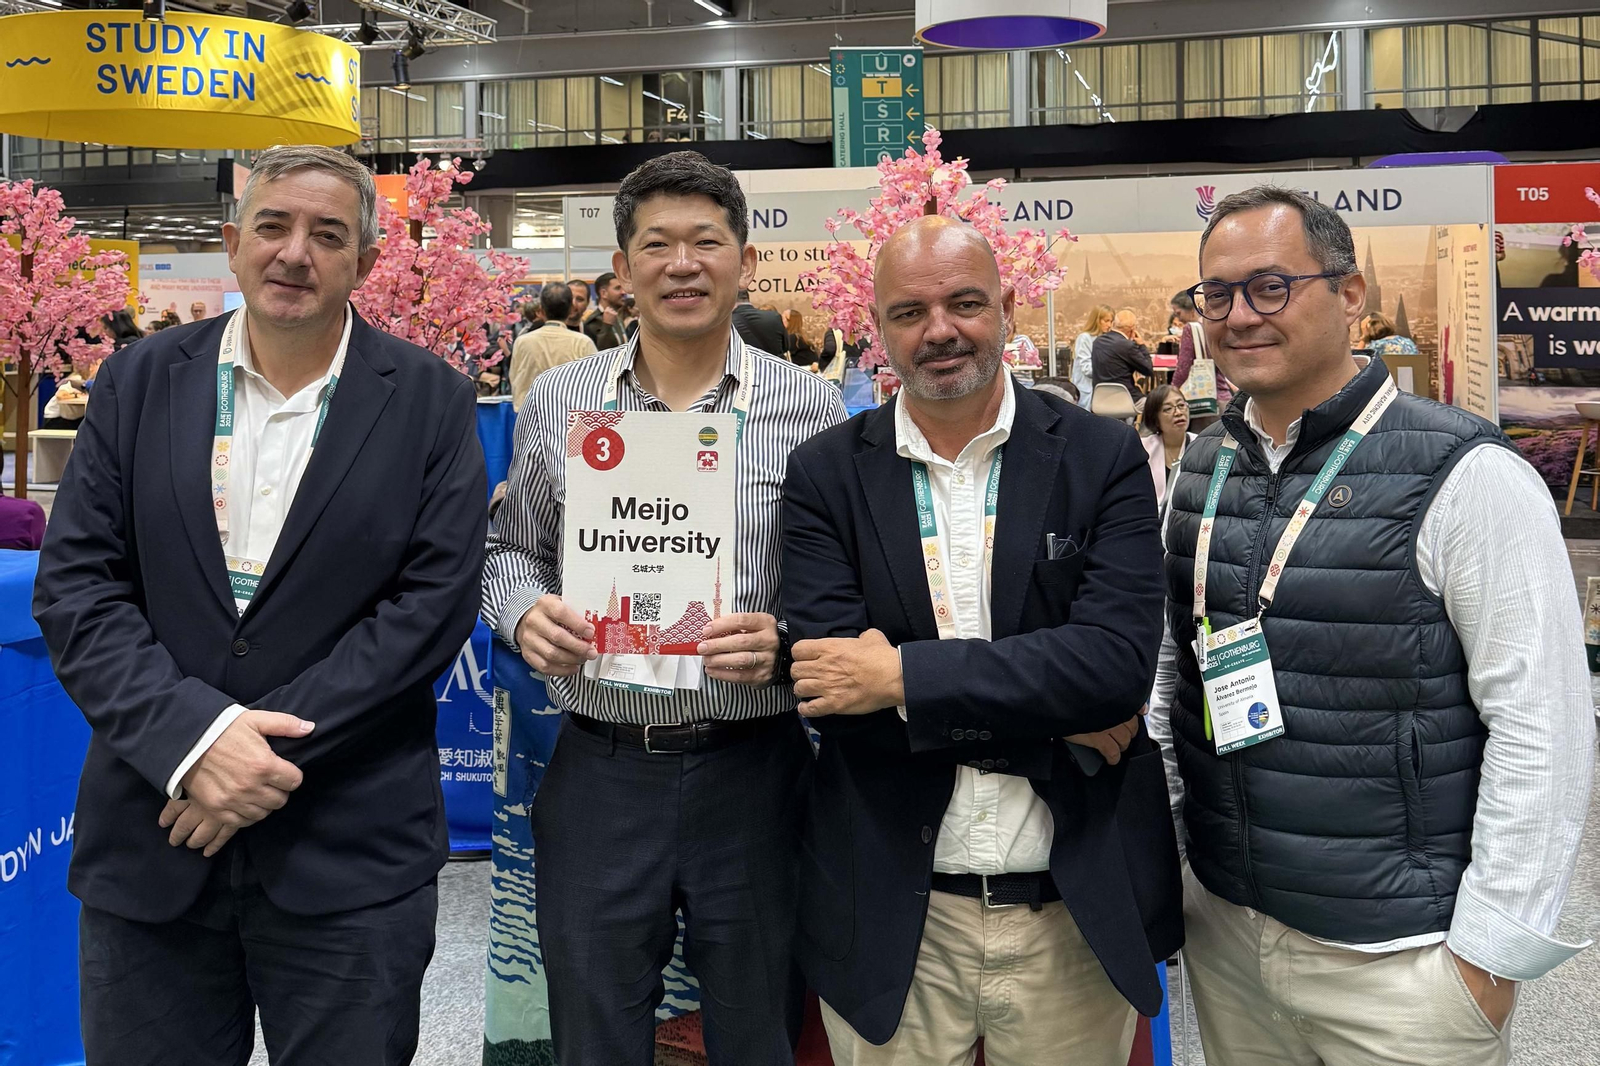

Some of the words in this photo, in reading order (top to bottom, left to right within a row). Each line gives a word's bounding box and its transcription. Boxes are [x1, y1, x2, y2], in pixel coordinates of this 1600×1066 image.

[86, 22, 210, 55] STUDY
[224, 29, 265, 63] IN
[875, 56, 888, 71] U
[97, 64, 255, 101] SWEDEN
[876, 80, 888, 95] T
[666, 108, 689, 123] F4
[877, 103, 889, 119] S
[877, 127, 890, 142] R
[1516, 187, 1549, 202] T05
[579, 208, 600, 219] T07
[780, 247, 798, 262] to
[1503, 301, 1524, 322] A
[1528, 306, 1600, 322] warm
[1548, 333, 1567, 356] is
[220, 370, 229, 411] GOTHENBURG
[596, 437, 611, 462] 3
[1314, 453, 1345, 496] GOTHENBURG
[914, 469, 927, 512] GOTHENBURG
[1209, 470, 1227, 510] GOTHENBURG
[611, 496, 689, 526] Meijo
[578, 528, 721, 559] University
[632, 564, 665, 574] 名城大学
[1219, 640, 1260, 661] GOTHENBURG
[643, 686, 672, 695] EXHIBITOR
[1214, 683, 1229, 694] Jose
[1230, 674, 1256, 688] Antonio
[1216, 690, 1235, 702] Álvarez
[1235, 683, 1258, 695] Bermejo
[1217, 701, 1235, 710] University
[1218, 745, 1231, 753] FULL
[1230, 740, 1246, 749] WEEK
[1257, 727, 1283, 741] EXHIBITOR
